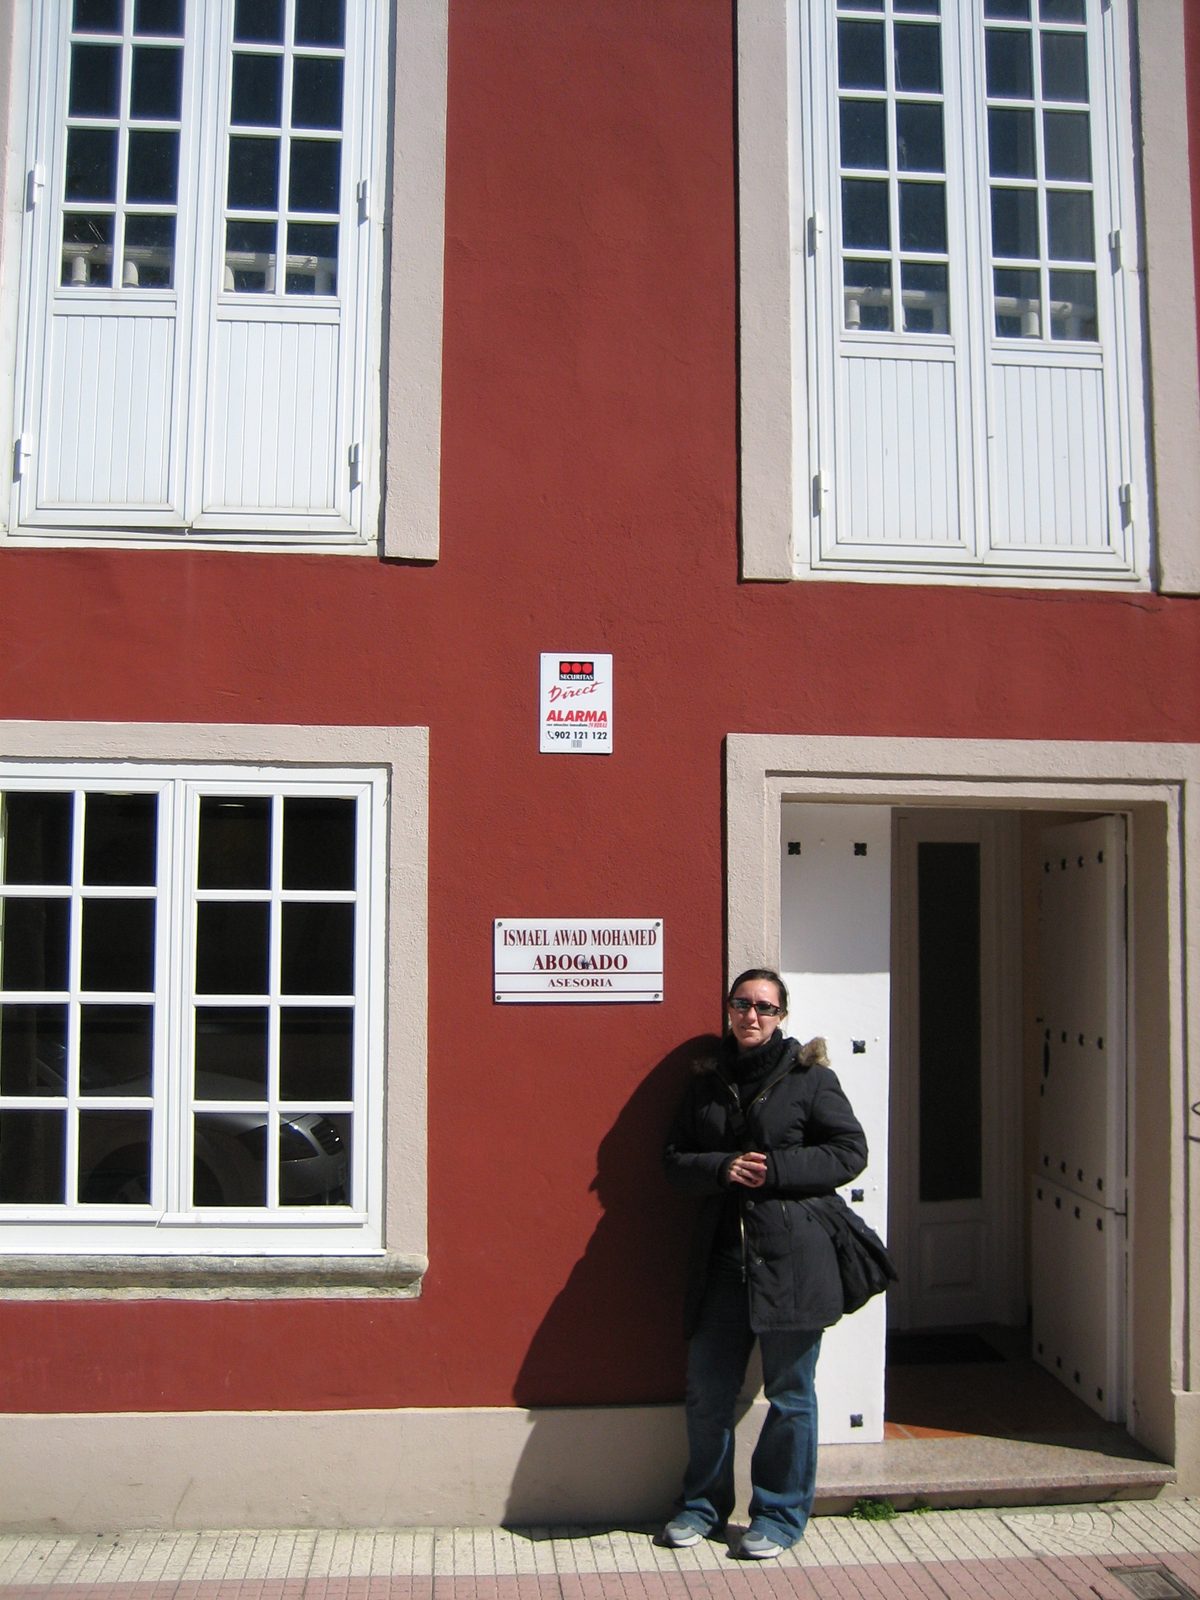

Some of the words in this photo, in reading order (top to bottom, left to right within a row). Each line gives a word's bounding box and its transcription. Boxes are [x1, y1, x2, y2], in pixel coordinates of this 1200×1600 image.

[548, 681, 604, 702] Direct
[546, 709, 607, 722] ALARMA
[554, 731, 570, 739] 902
[574, 731, 588, 739] 121
[592, 731, 607, 739] 122
[503, 929, 550, 946] ISMAEL
[553, 929, 587, 946] AWAD
[590, 929, 657, 946] MOHAMED
[533, 954, 628, 970] ABOGADO
[548, 978, 613, 987] ASESORIA
